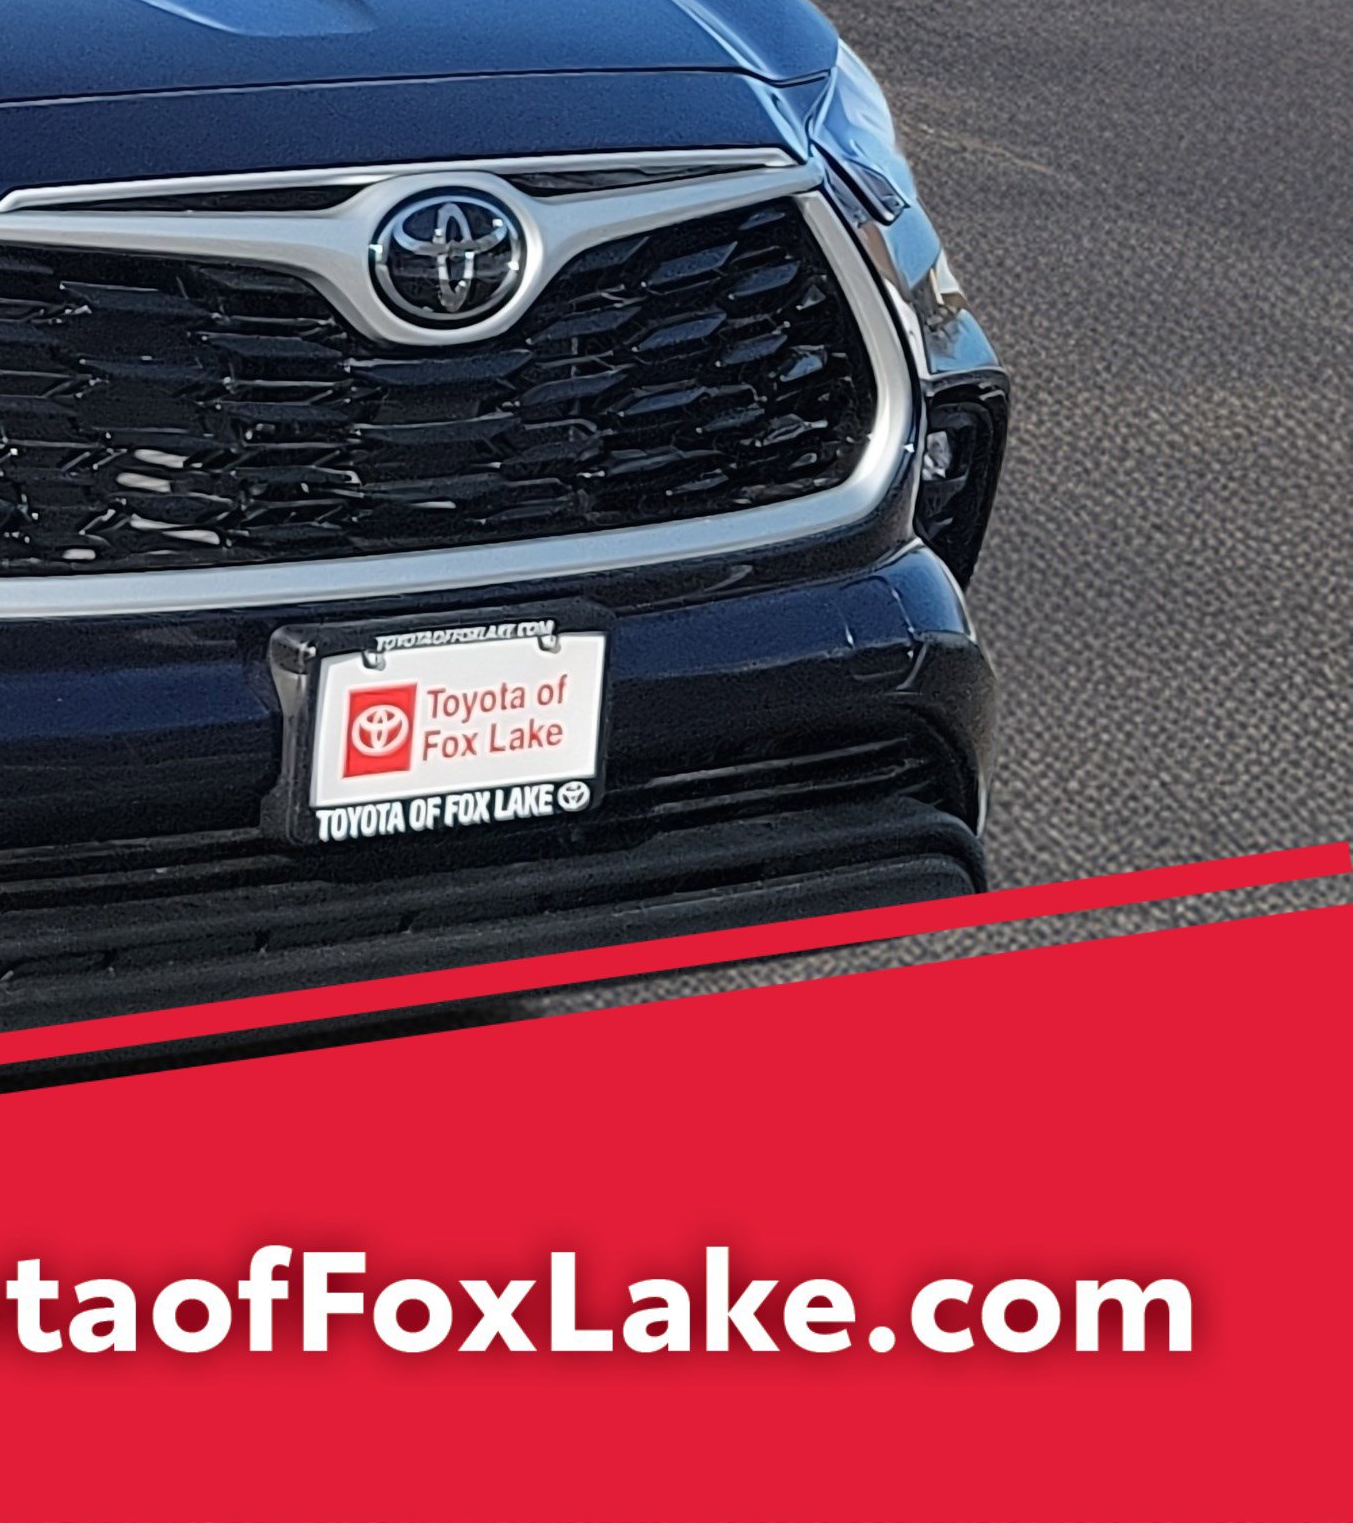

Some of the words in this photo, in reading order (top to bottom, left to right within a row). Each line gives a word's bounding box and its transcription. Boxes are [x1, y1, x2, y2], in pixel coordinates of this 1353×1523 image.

[375, 619, 555, 652] TOYOTAOFFOXLAKECOM
[425, 682, 526, 724] Toyota
[536, 674, 569, 707] of
[422, 729, 478, 761] Fox
[488, 718, 565, 754] Lake
[315, 801, 406, 842] TOYOTA
[408, 796, 442, 831] OF
[444, 789, 492, 828] FOX
[494, 784, 556, 821] LAKE
